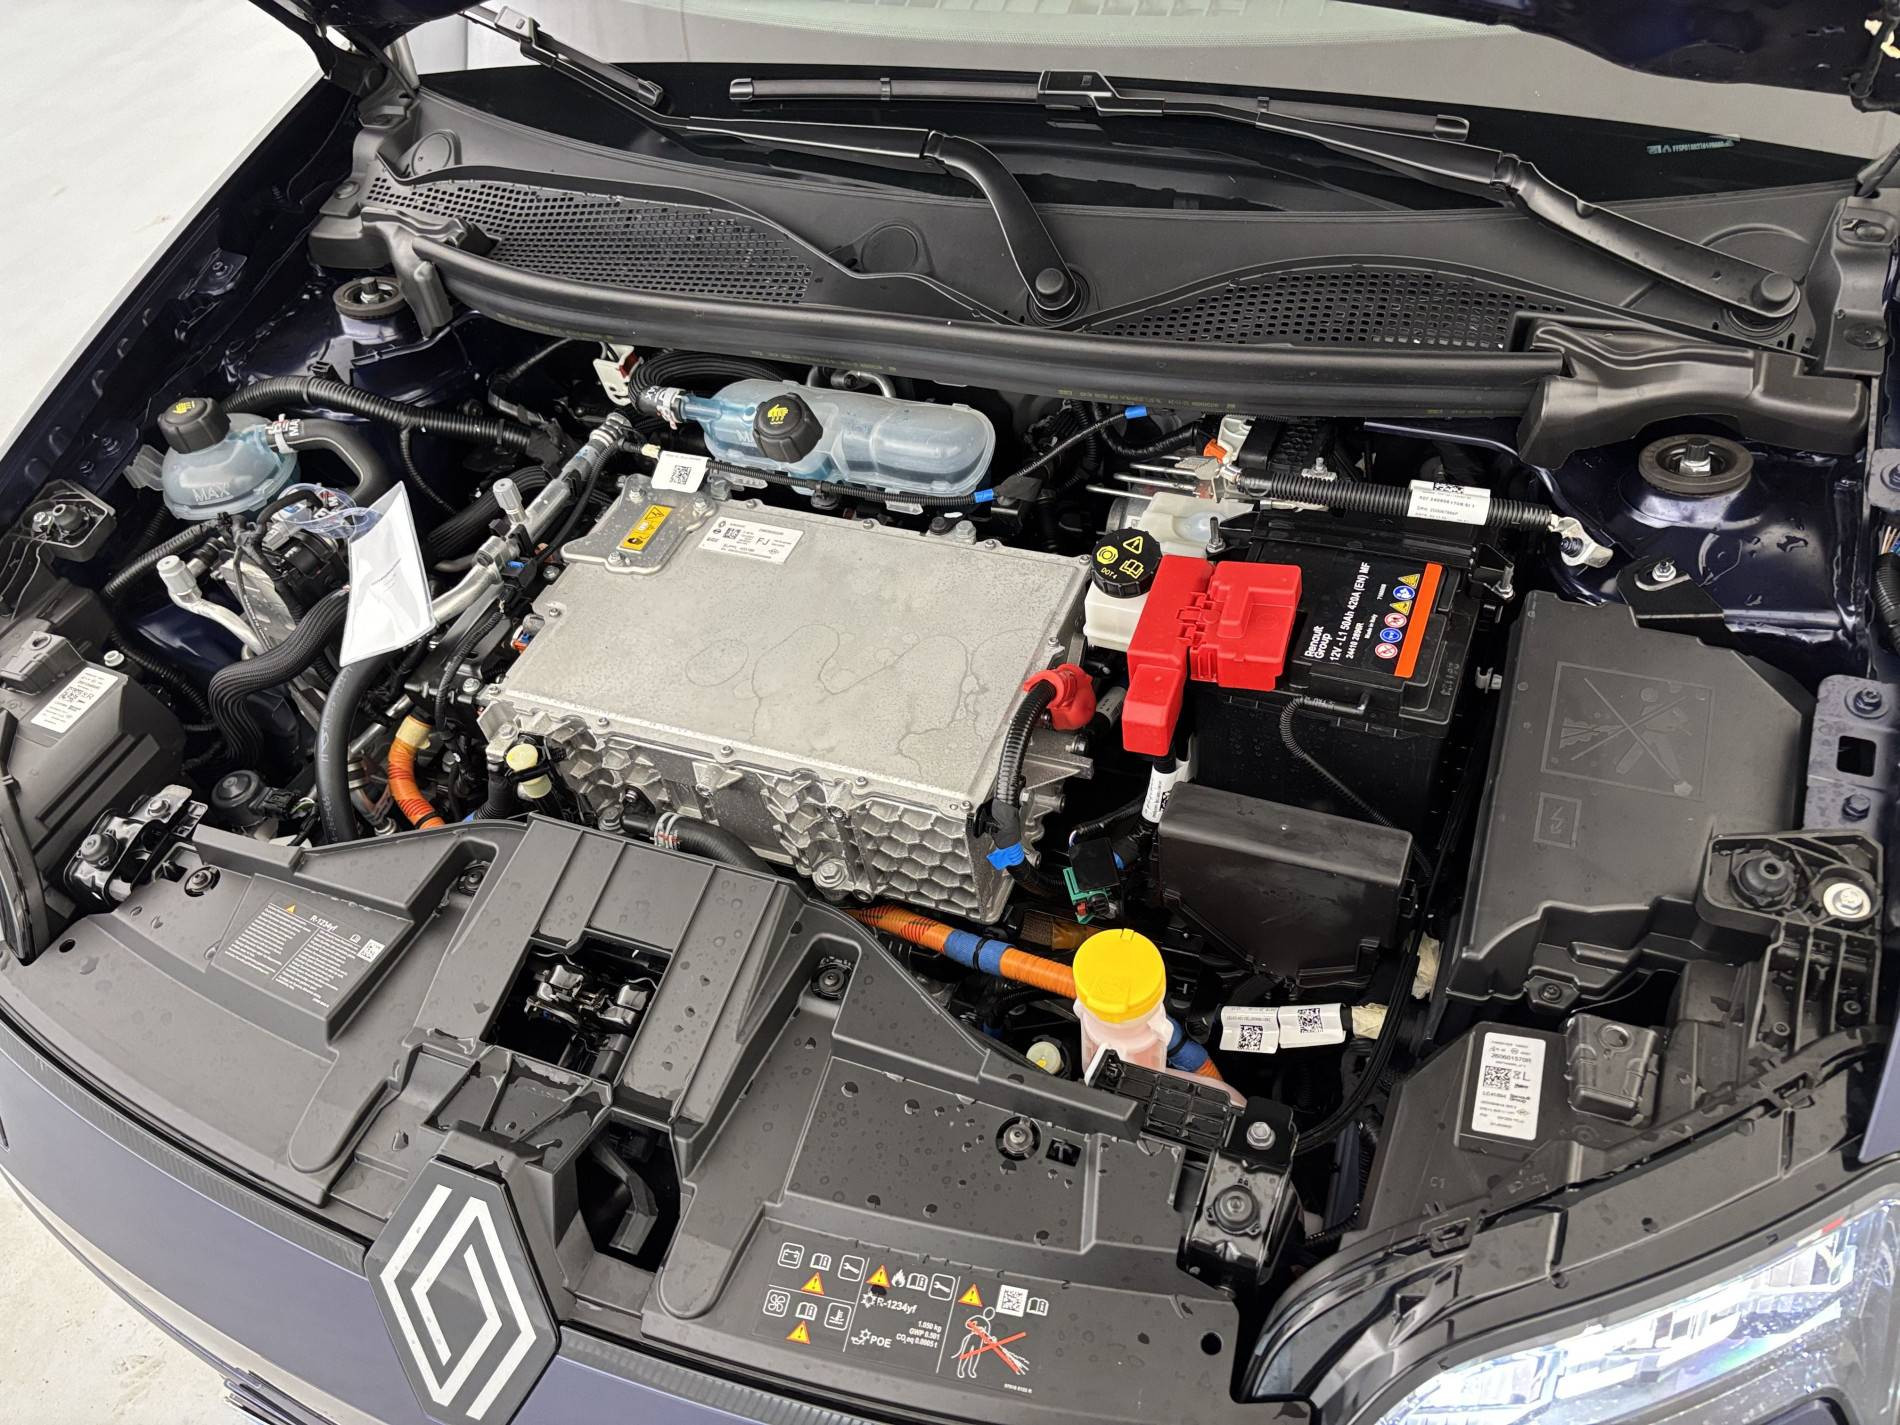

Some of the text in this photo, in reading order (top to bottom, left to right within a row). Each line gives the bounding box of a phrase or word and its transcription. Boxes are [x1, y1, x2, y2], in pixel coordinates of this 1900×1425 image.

[192, 484, 230, 501] MAX
[1100, 567, 1113, 577] DOT
[1359, 562, 1370, 573] MF
[1354, 574, 1369, 591] (EN)
[1347, 592, 1361, 610] 420A
[1340, 611, 1355, 630] 50Ah
[1304, 625, 1324, 657] Renault
[1336, 631, 1347, 641] L1
[1314, 632, 1332, 658] Group
[1329, 646, 1342, 660] 12V
[876, 1297, 917, 1314] R-1234yf
[909, 1327, 925, 1336] GWP
[932, 1324, 942, 1332] kg
[869, 1333, 892, 1348] POE
